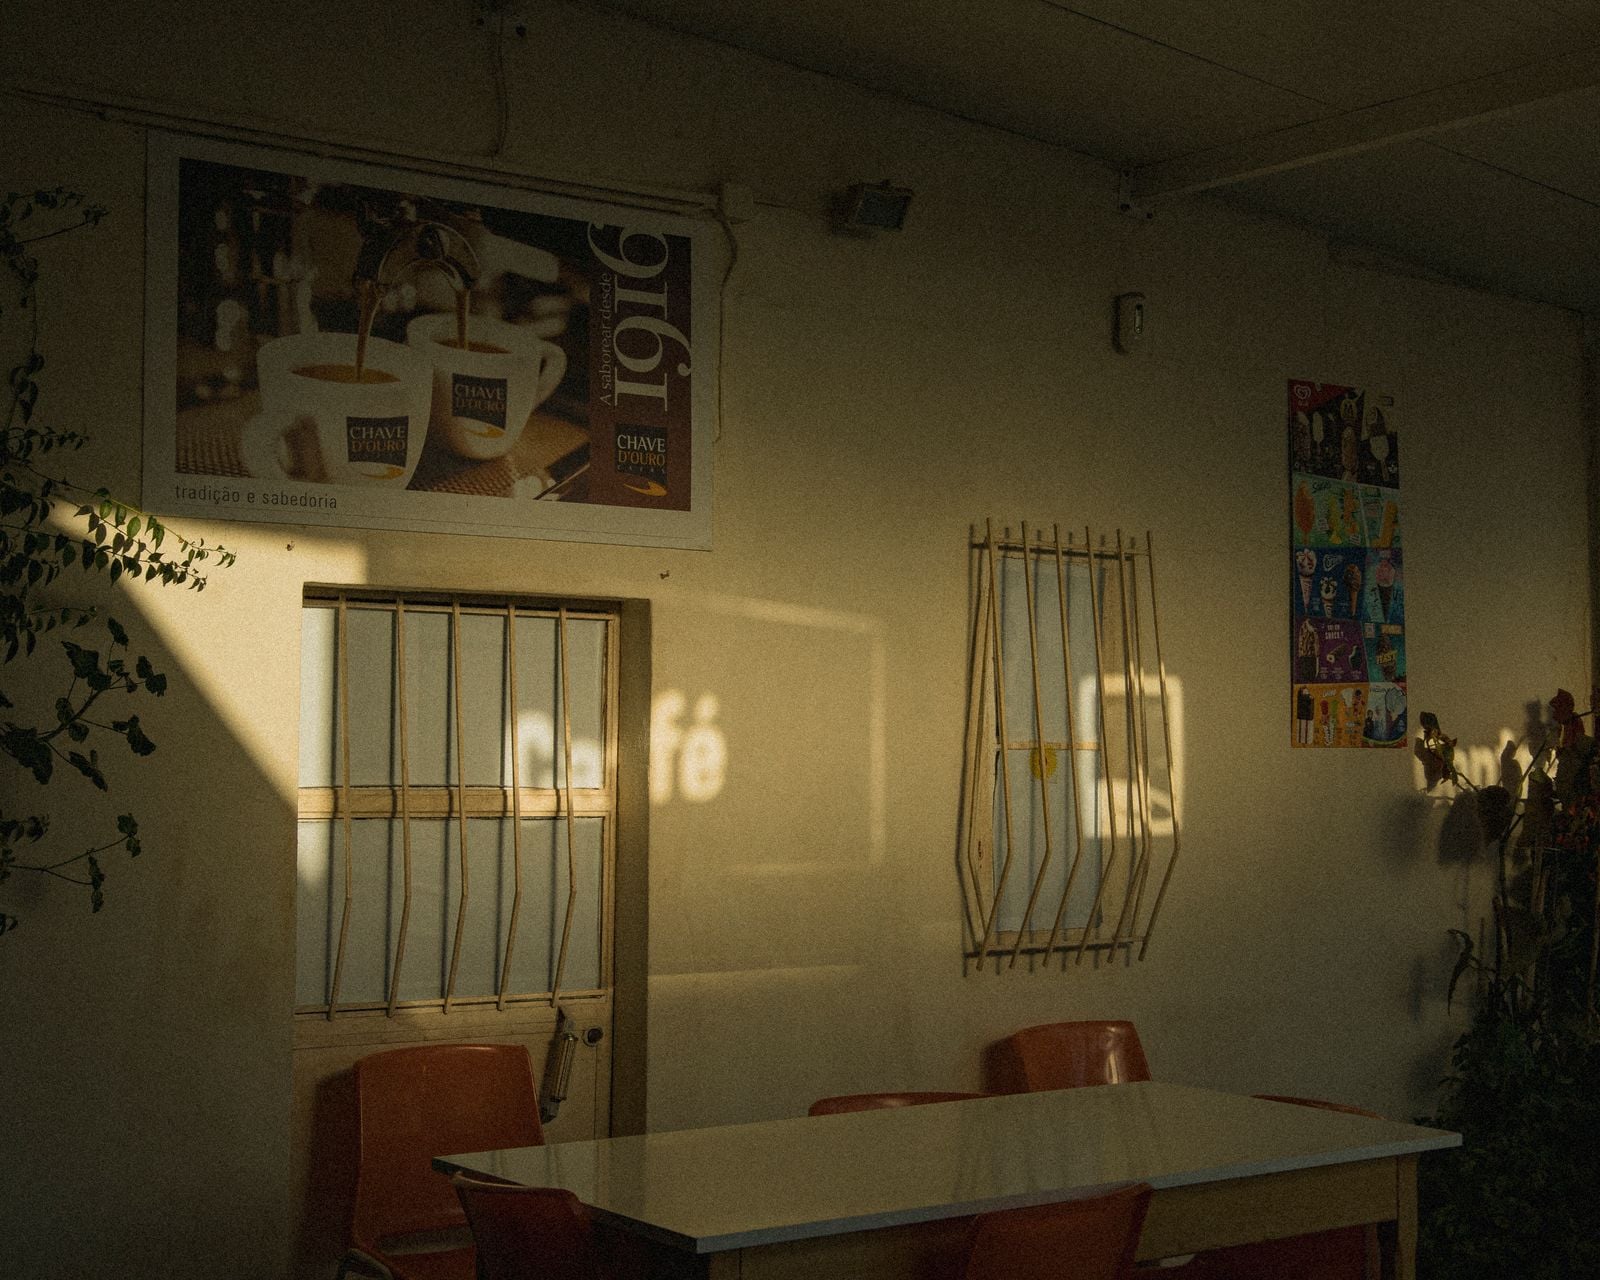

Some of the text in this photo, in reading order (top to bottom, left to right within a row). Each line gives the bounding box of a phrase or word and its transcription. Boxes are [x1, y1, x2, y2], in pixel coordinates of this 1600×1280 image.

[599, 272, 612, 407] A saborear desde
[454, 383, 506, 401] CHAVE
[350, 425, 406, 440] CHAVE
[352, 439, 406, 452] D'OURO
[617, 434, 666, 453] CHAVE
[618, 450, 666, 467] D'OURO
[174, 484, 338, 509] tradição e sabedoria
